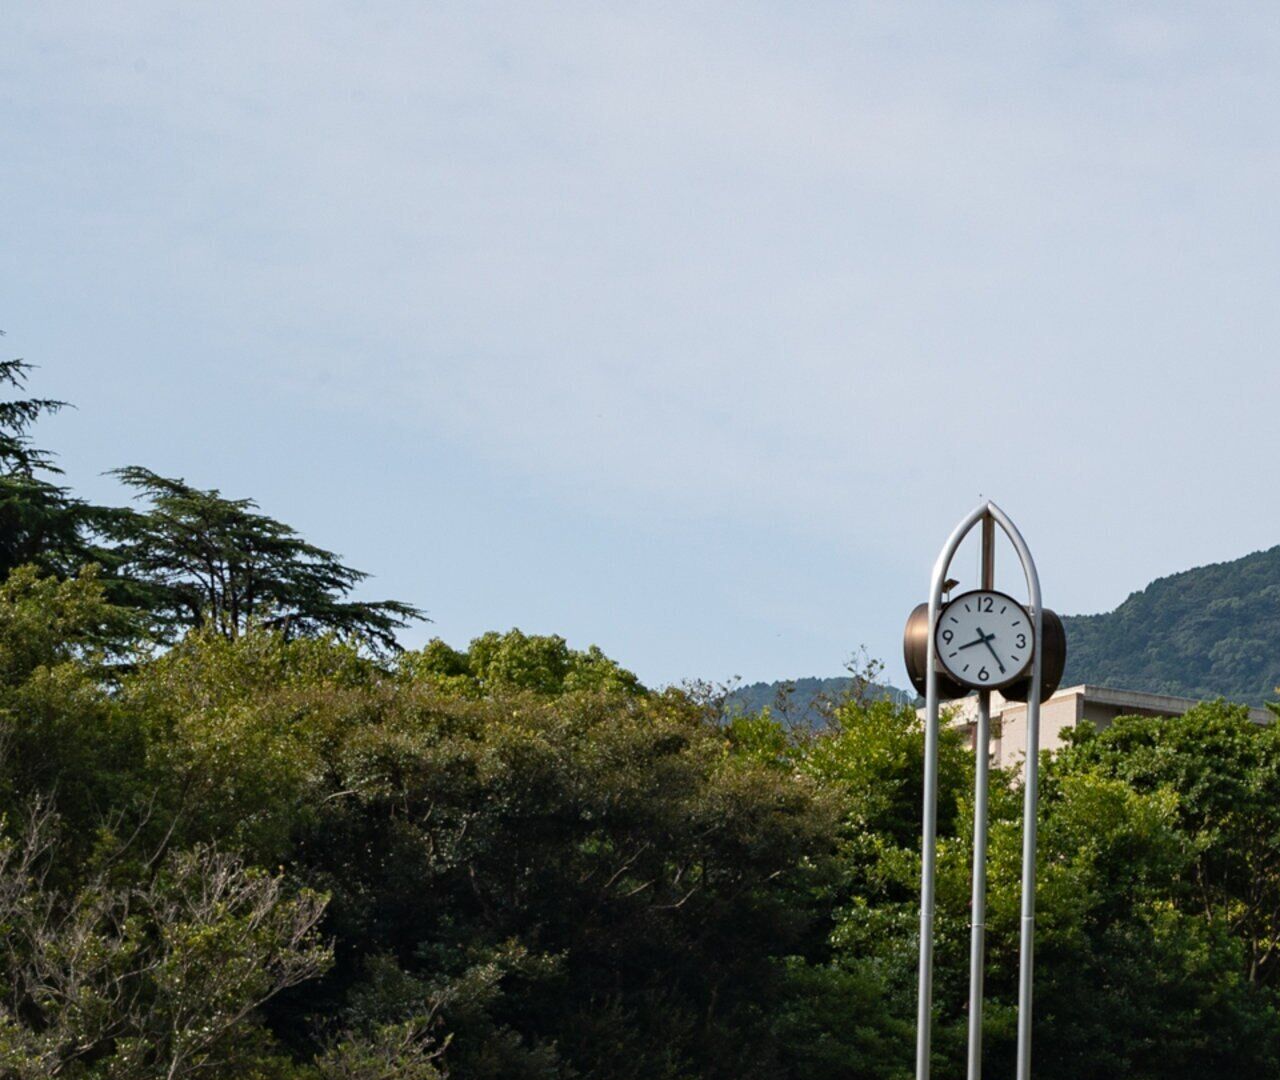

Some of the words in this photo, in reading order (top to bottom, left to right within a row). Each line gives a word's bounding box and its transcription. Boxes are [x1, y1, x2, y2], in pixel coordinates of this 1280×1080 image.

[978, 597, 993, 613] 12
[942, 629, 954, 645] 9
[1016, 633, 1026, 649] 3
[978, 666, 989, 681] 6
